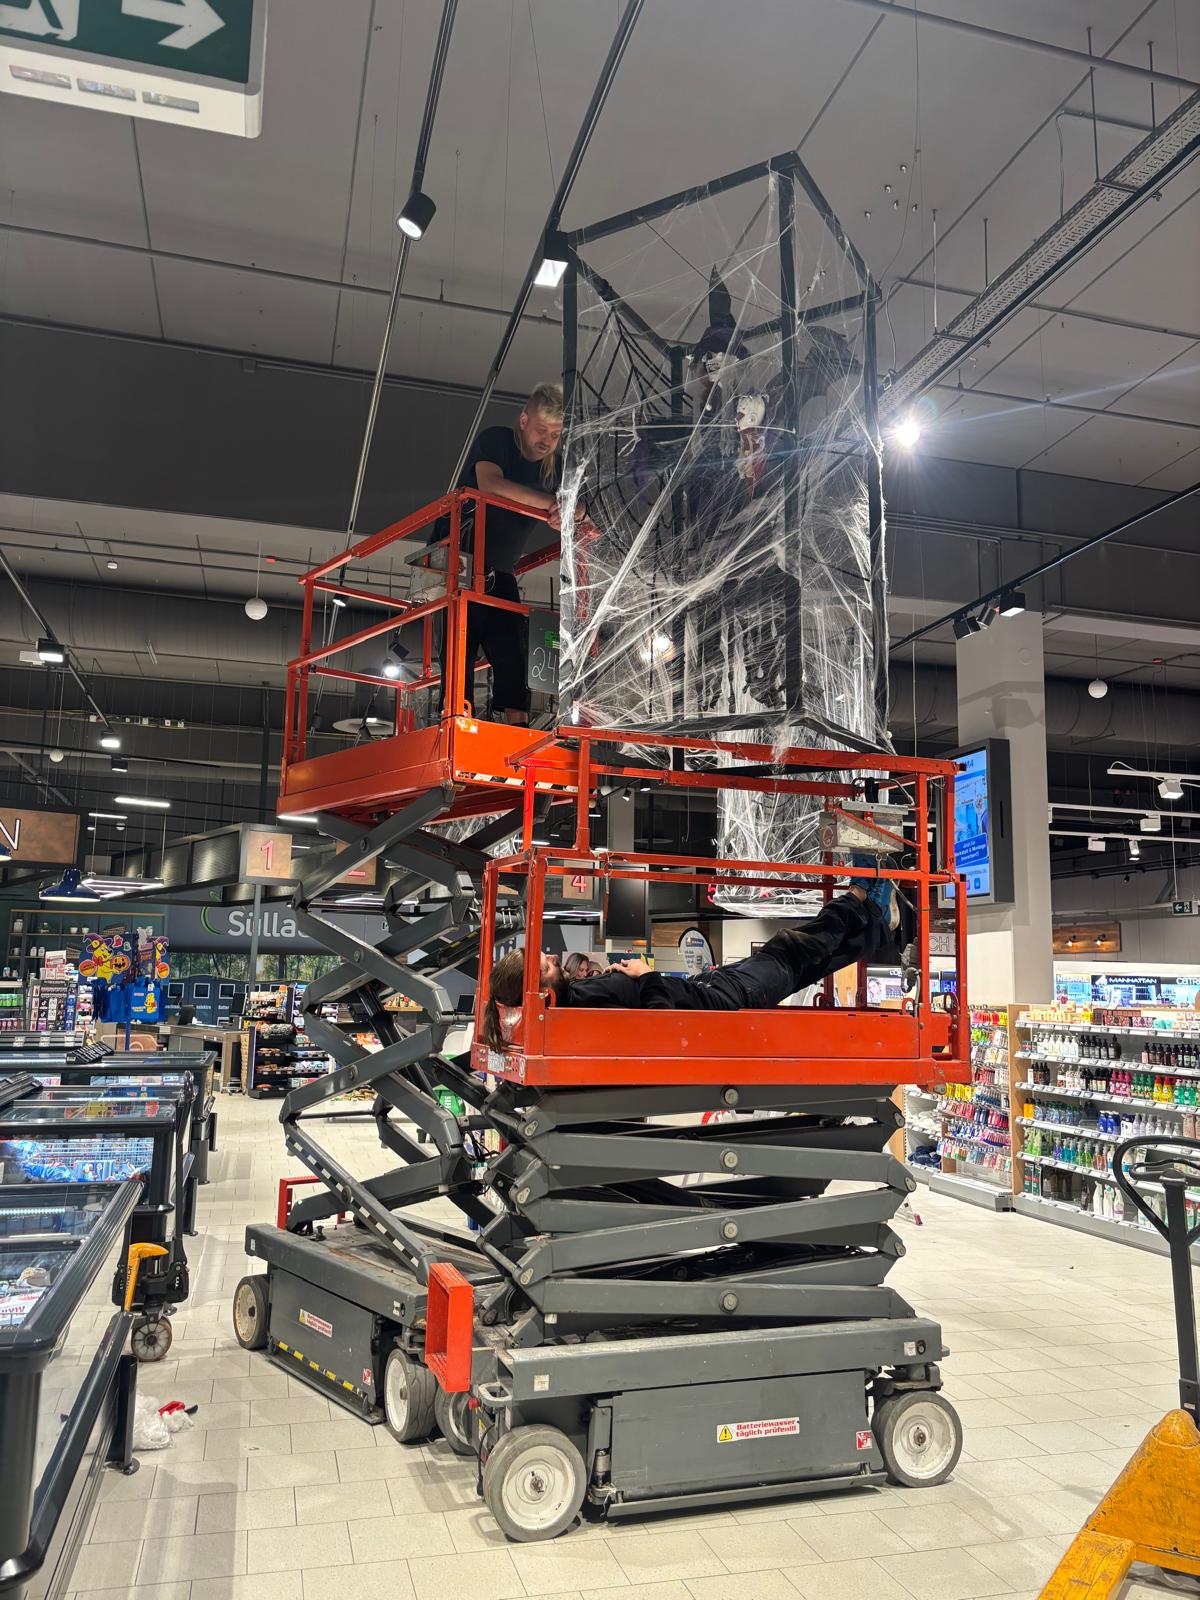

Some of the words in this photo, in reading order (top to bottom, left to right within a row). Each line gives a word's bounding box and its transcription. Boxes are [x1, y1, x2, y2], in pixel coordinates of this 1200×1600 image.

[532, 647, 560, 683] 24
[261, 840, 273, 870] 1
[572, 875, 587, 893] 4
[228, 911, 310, 938] Sülla
[737, 1420, 795, 1430] Batteriewasser
